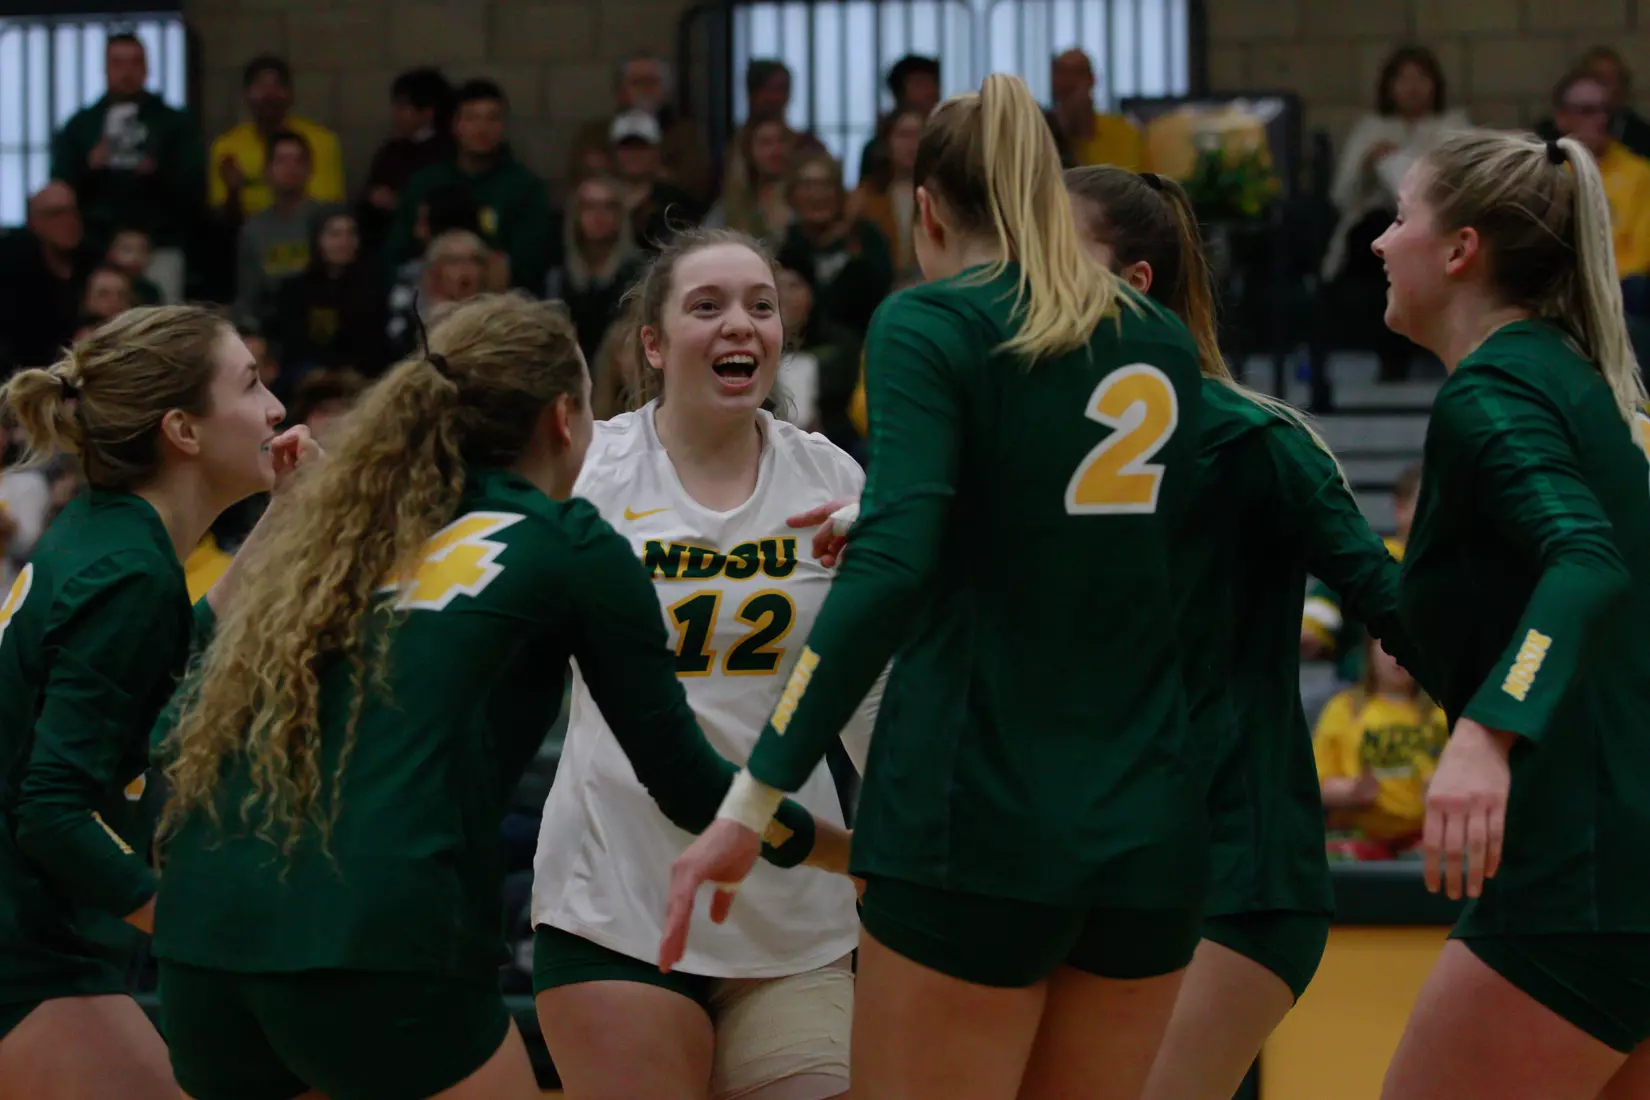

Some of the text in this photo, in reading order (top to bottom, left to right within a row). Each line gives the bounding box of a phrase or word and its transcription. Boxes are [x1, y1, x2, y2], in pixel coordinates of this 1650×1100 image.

[1063, 361, 1180, 516] 2
[644, 536, 797, 579] NDSU
[667, 588, 796, 677] 12
